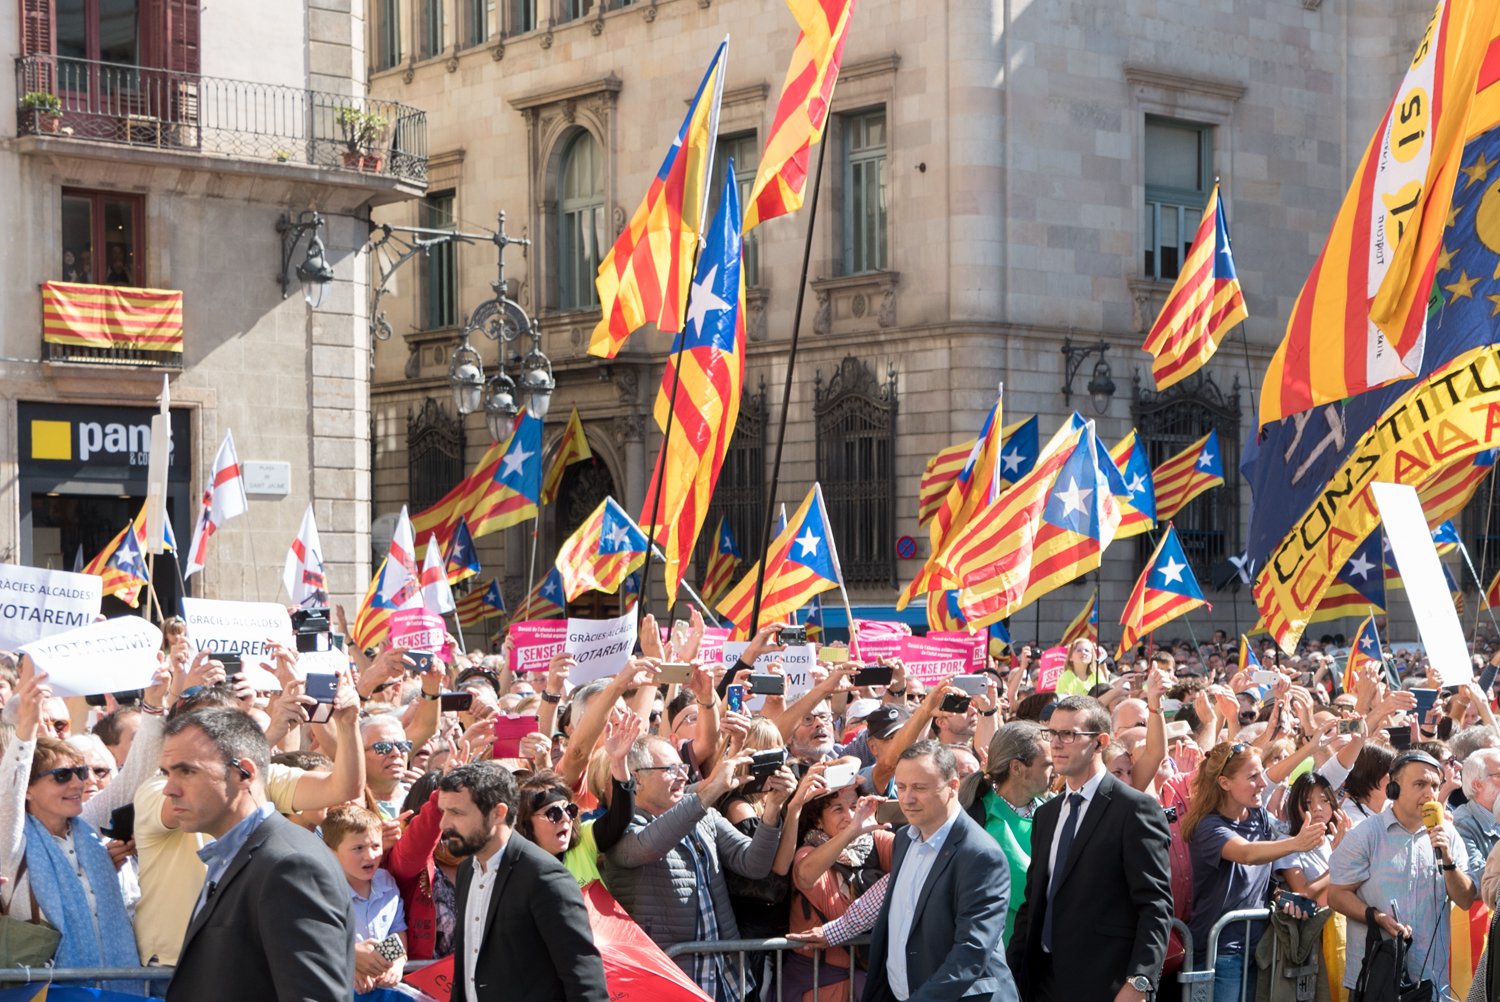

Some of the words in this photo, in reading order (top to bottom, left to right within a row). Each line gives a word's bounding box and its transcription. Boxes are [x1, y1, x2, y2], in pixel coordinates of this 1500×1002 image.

[569, 632, 606, 643] GRÀCIES
[524, 645, 555, 661] SENSE
[909, 662, 938, 676] SENSE
[940, 660, 962, 673] POR!
